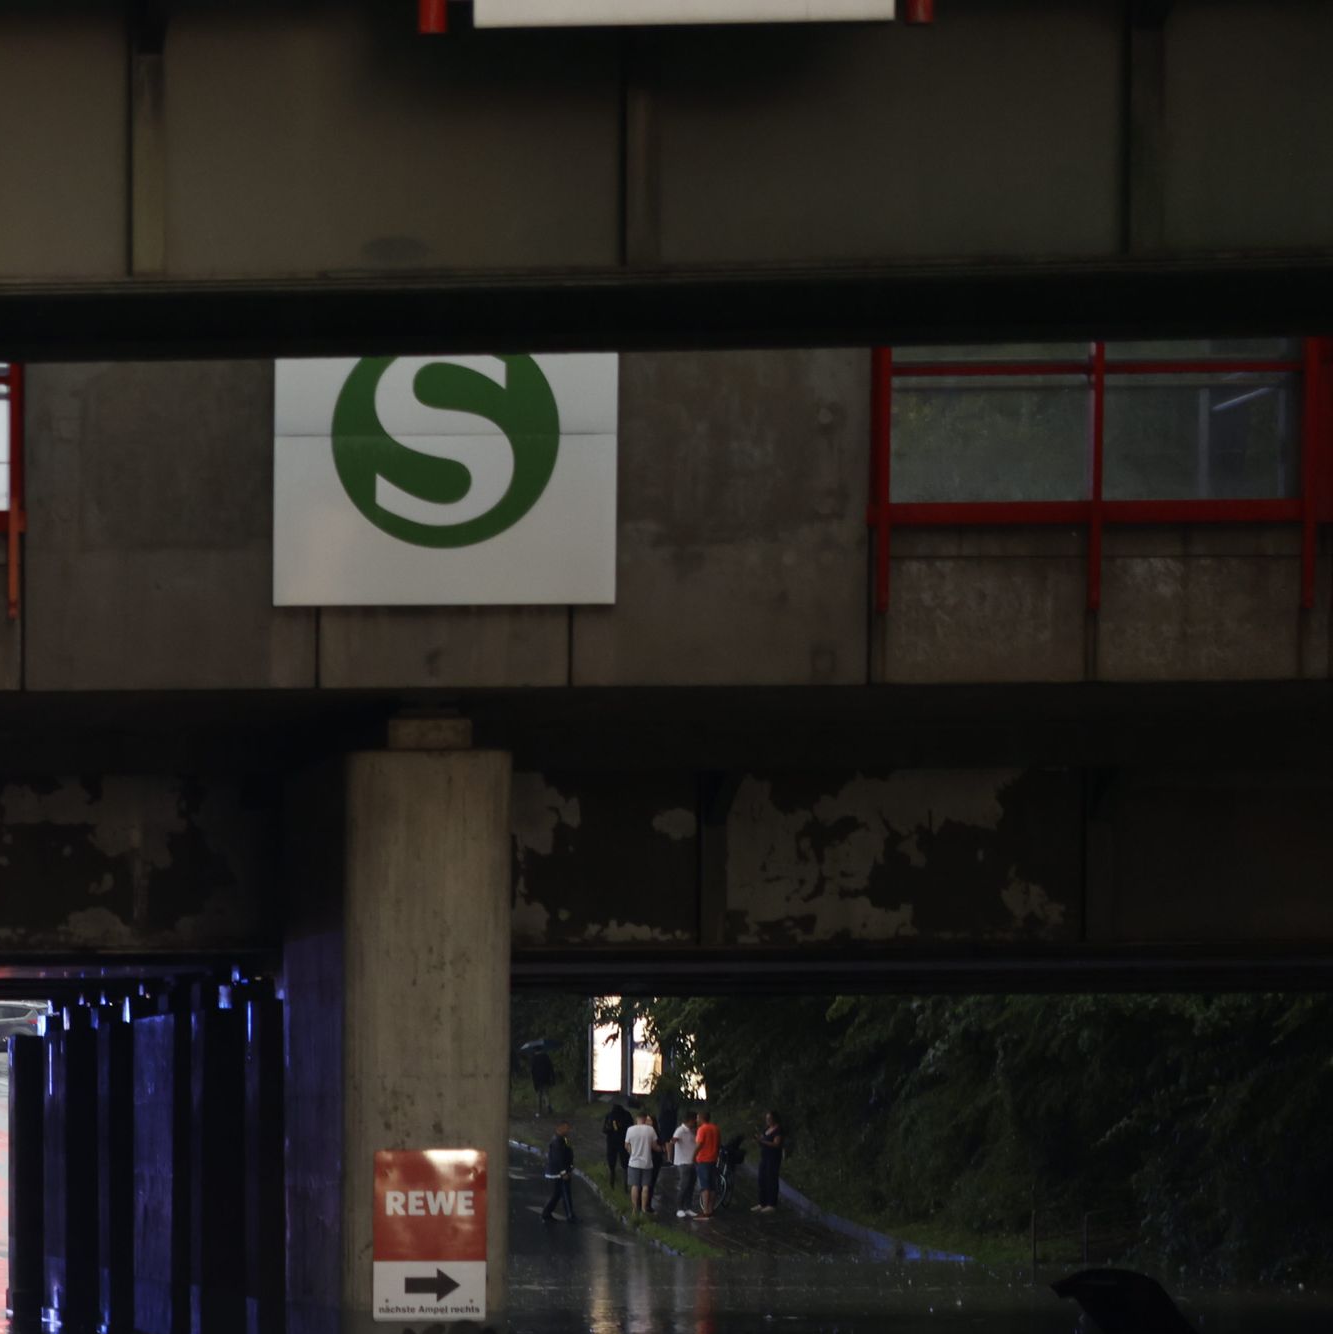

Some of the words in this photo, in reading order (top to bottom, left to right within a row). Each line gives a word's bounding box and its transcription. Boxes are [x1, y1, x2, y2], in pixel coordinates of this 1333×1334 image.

[374, 355, 515, 527] S
[385, 1190, 475, 1216] REWE
[378, 1304, 416, 1314] nächste
[418, 1304, 448, 1315] Ampel
[450, 1304, 481, 1314] rechts
